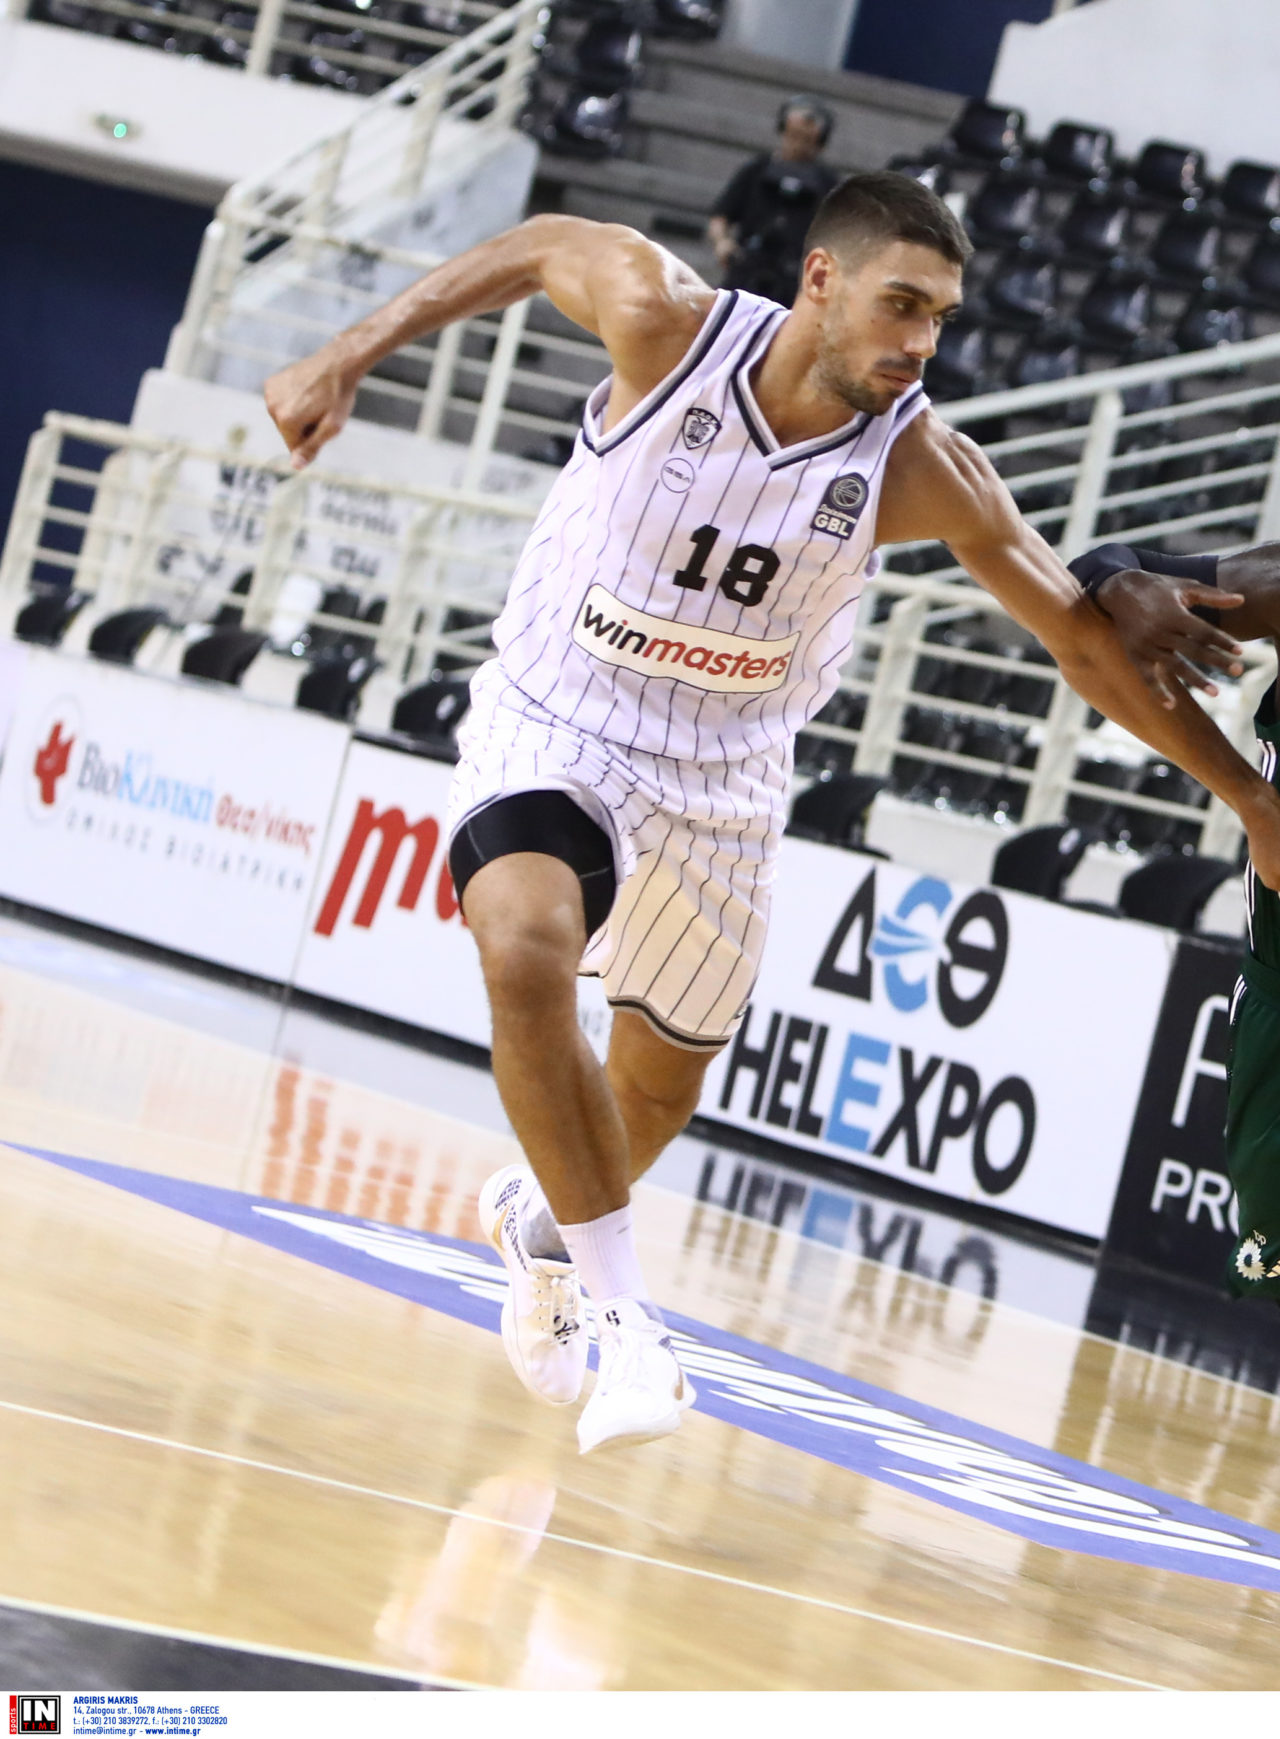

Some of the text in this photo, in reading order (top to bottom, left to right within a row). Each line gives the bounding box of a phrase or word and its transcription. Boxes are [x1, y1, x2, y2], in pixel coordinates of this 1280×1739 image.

[672, 523, 781, 608] 18
[813, 513, 850, 537] GBL
[582, 603, 792, 680] winmasters
[718, 1002, 1038, 1196] HELEXPO
